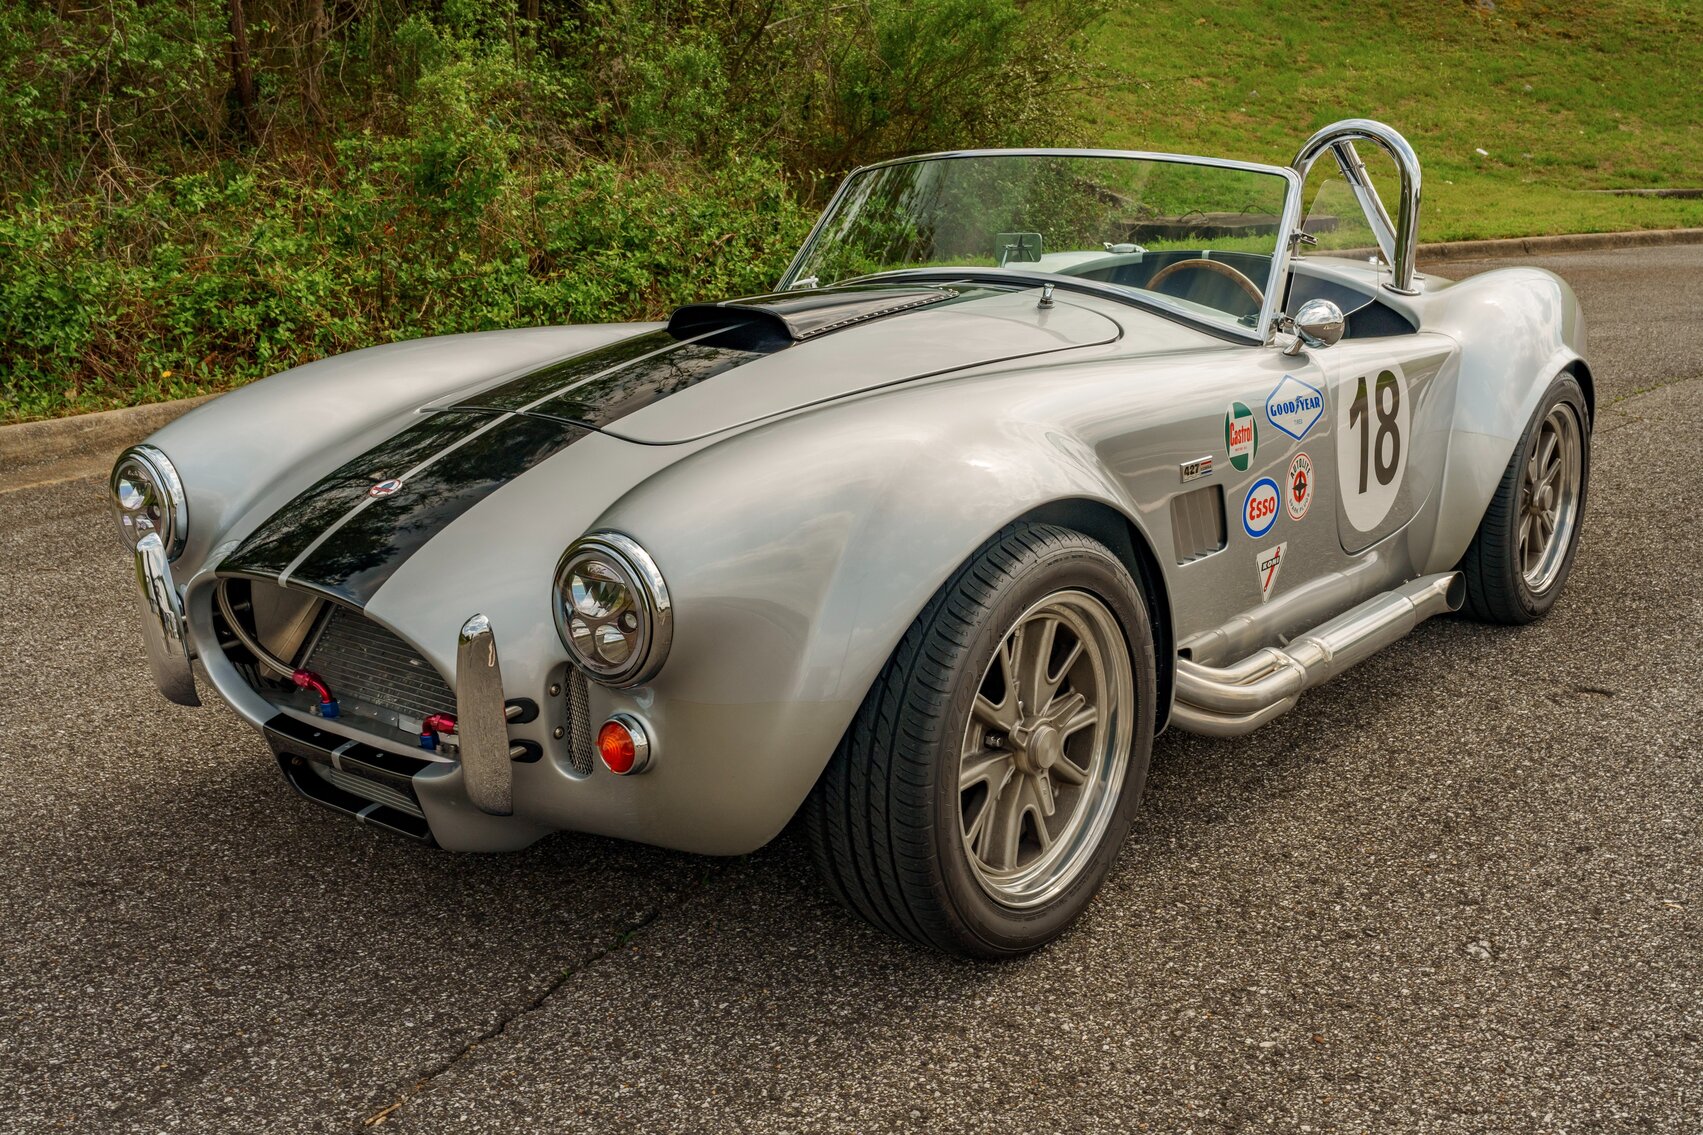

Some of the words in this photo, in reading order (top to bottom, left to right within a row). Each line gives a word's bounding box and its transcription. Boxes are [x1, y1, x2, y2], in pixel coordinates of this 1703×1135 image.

[1230, 419, 1253, 447] Castrol
[1349, 369, 1401, 495] 18
[1184, 463, 1200, 477] 427
[1290, 458, 1311, 479] AUTOLITE
[1261, 556, 1281, 571] KONI
